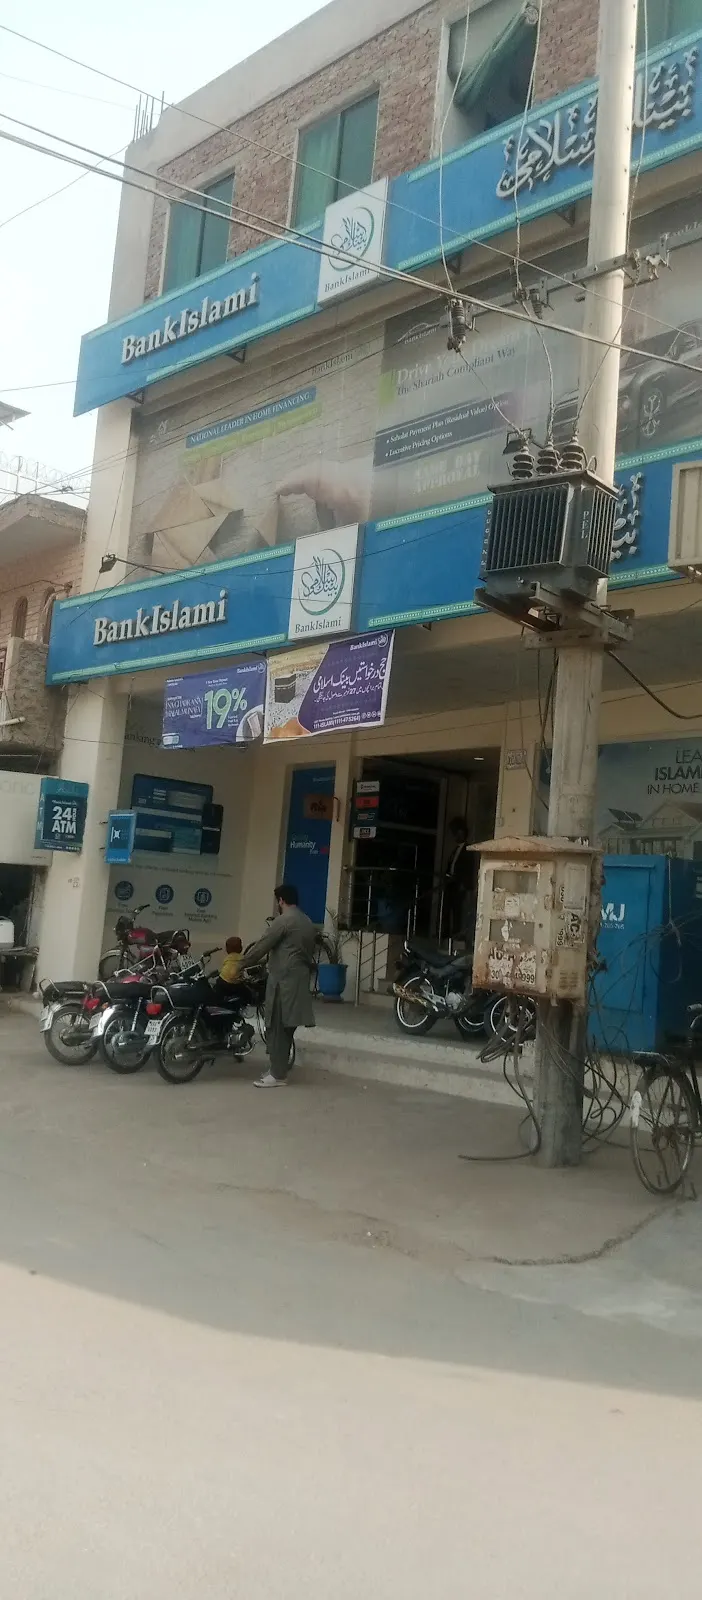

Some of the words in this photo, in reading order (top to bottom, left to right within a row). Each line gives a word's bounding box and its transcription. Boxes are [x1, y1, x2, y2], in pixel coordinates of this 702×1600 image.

[324, 268, 371, 293] BankIslami
[121, 272, 260, 365] BankIslami
[413, 372, 444, 391] Shariah
[447, 356, 494, 377] Compliant
[190, 426, 221, 444] NATIONAL
[221, 419, 244, 433] LEADER
[252, 408, 272, 420] HOME
[92, 589, 228, 647] BankIslami
[294, 616, 343, 634] BankIslami
[204, 687, 248, 729] 19%
[648, 784, 660, 795] IN
[663, 783, 699, 794] HOME
[52, 806, 72, 820] 24
[51, 820, 77, 834] ATM
[290, 841, 316, 849] Humanity
